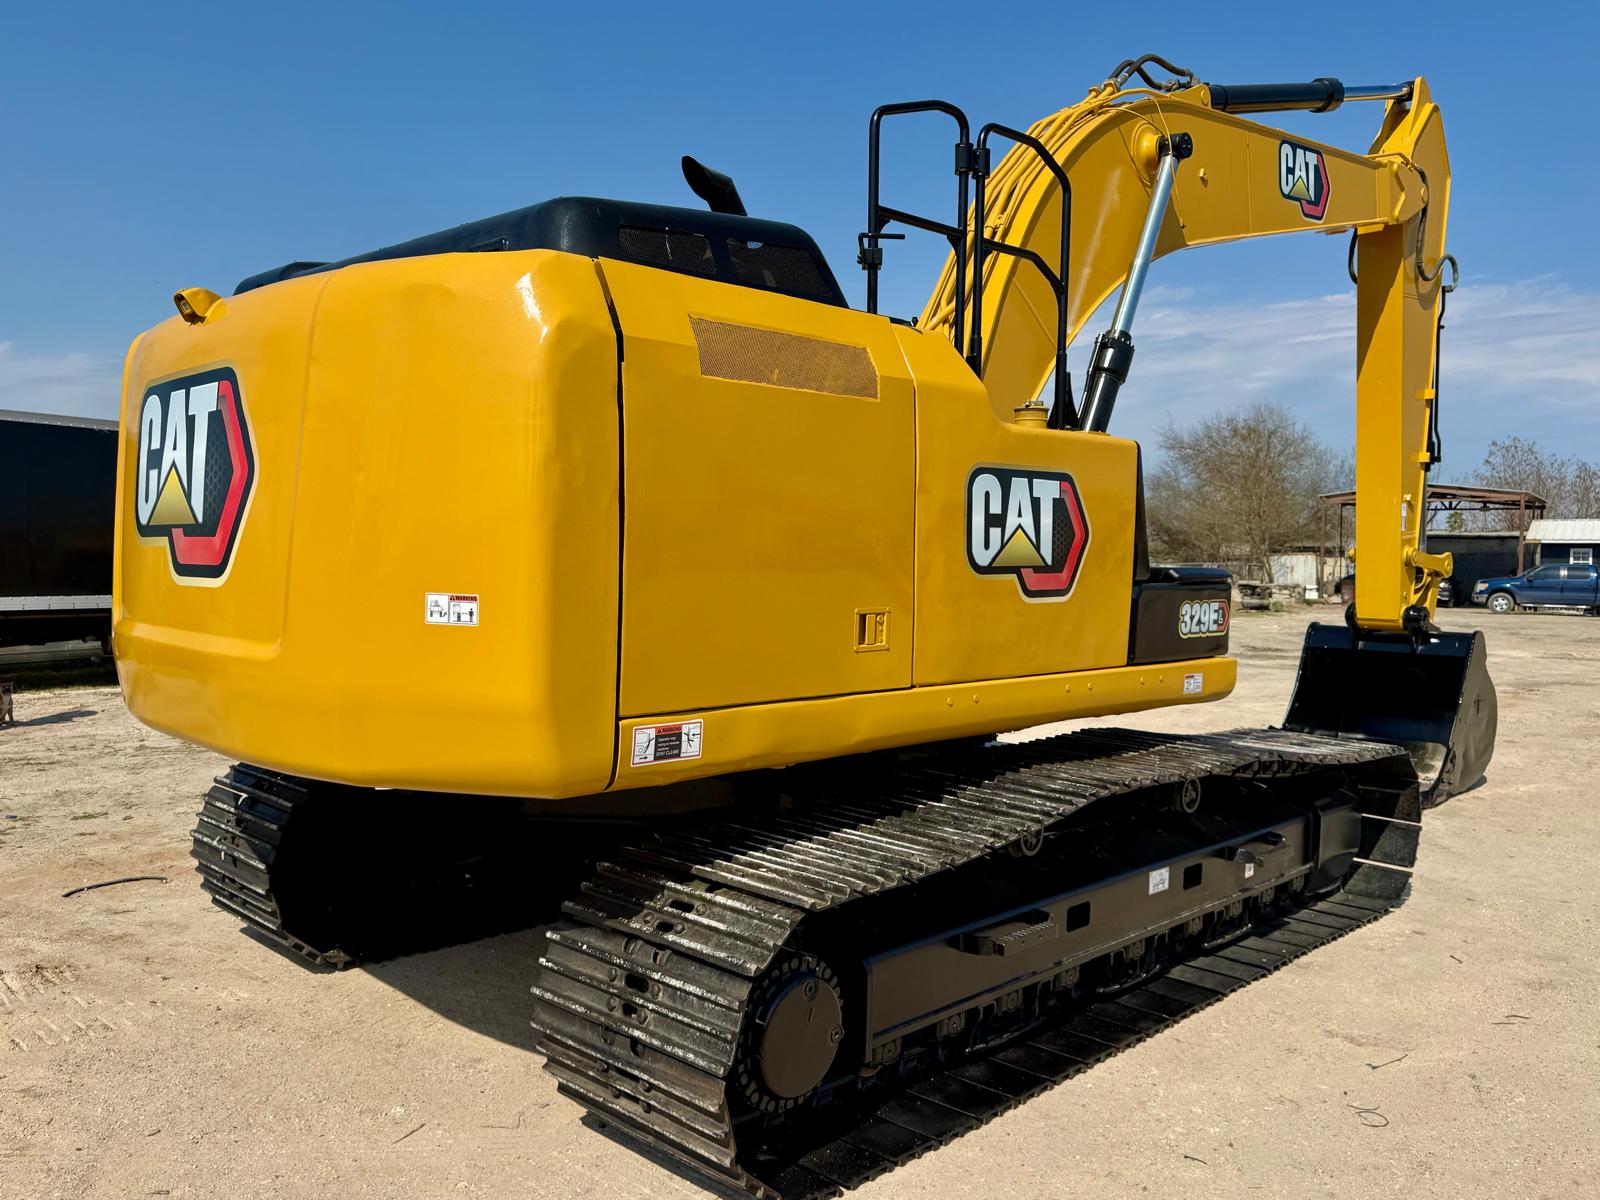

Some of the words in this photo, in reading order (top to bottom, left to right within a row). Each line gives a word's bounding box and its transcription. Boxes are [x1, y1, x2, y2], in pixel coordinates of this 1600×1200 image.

[1281, 143, 1318, 202] CAT
[138, 381, 219, 525] CAT
[972, 473, 1060, 567] CAT
